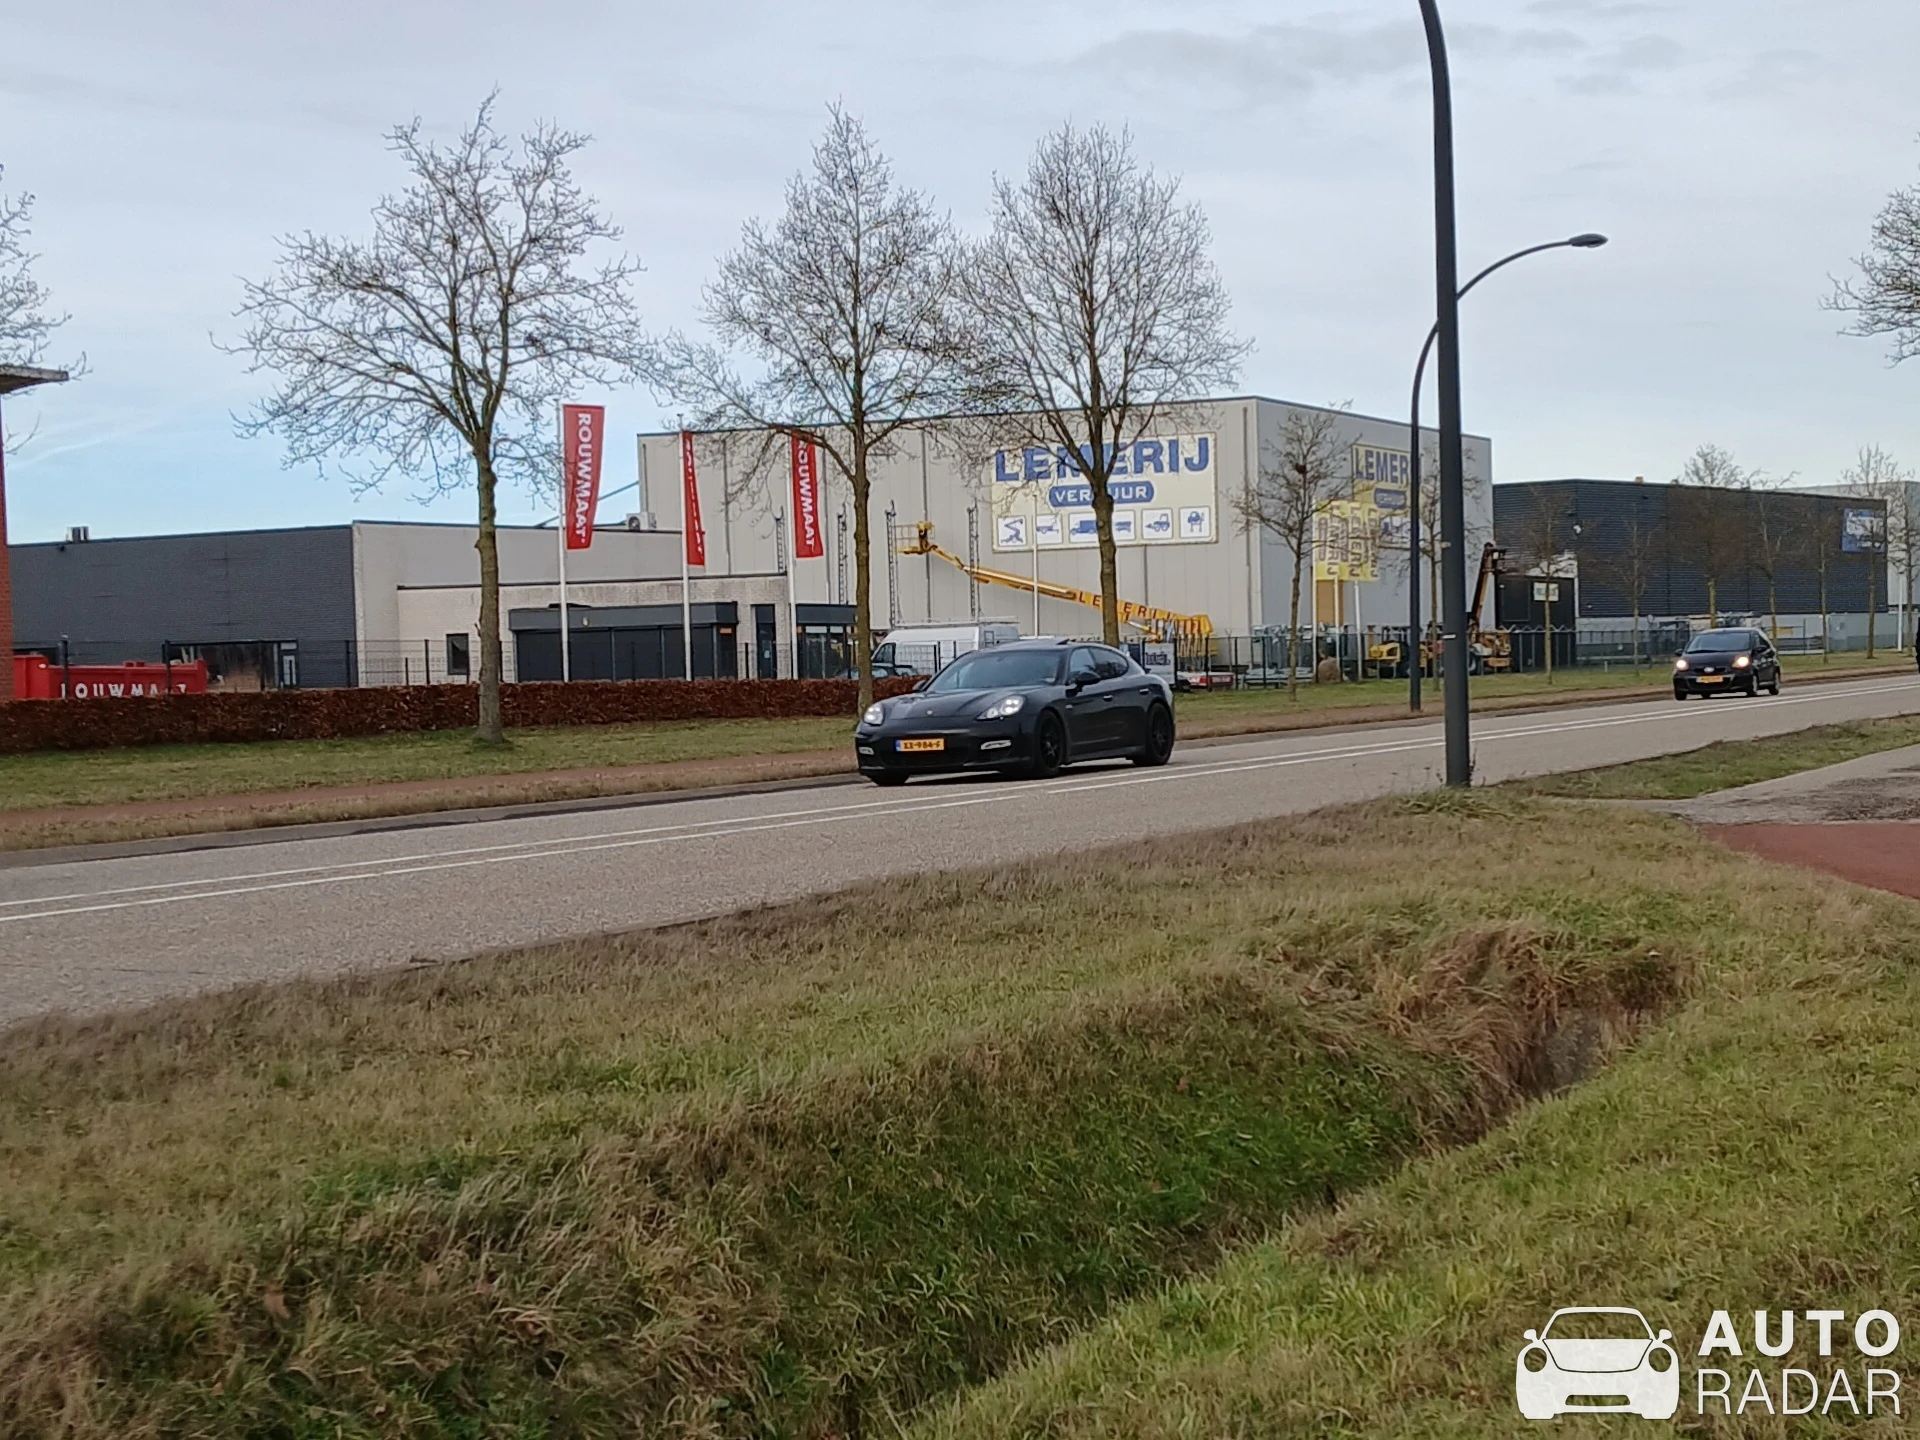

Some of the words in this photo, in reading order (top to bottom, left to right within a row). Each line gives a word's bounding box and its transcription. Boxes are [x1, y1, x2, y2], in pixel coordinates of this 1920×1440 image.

[575, 413, 592, 538] ROUWMAAT
[995, 437, 1209, 482] LEMERIJ
[1355, 447, 1421, 487] LEMER
[1055, 486, 1147, 503] VERUUR
[1079, 591, 1171, 622] LEERIJ
[61, 683, 187, 699] OUWMAT
